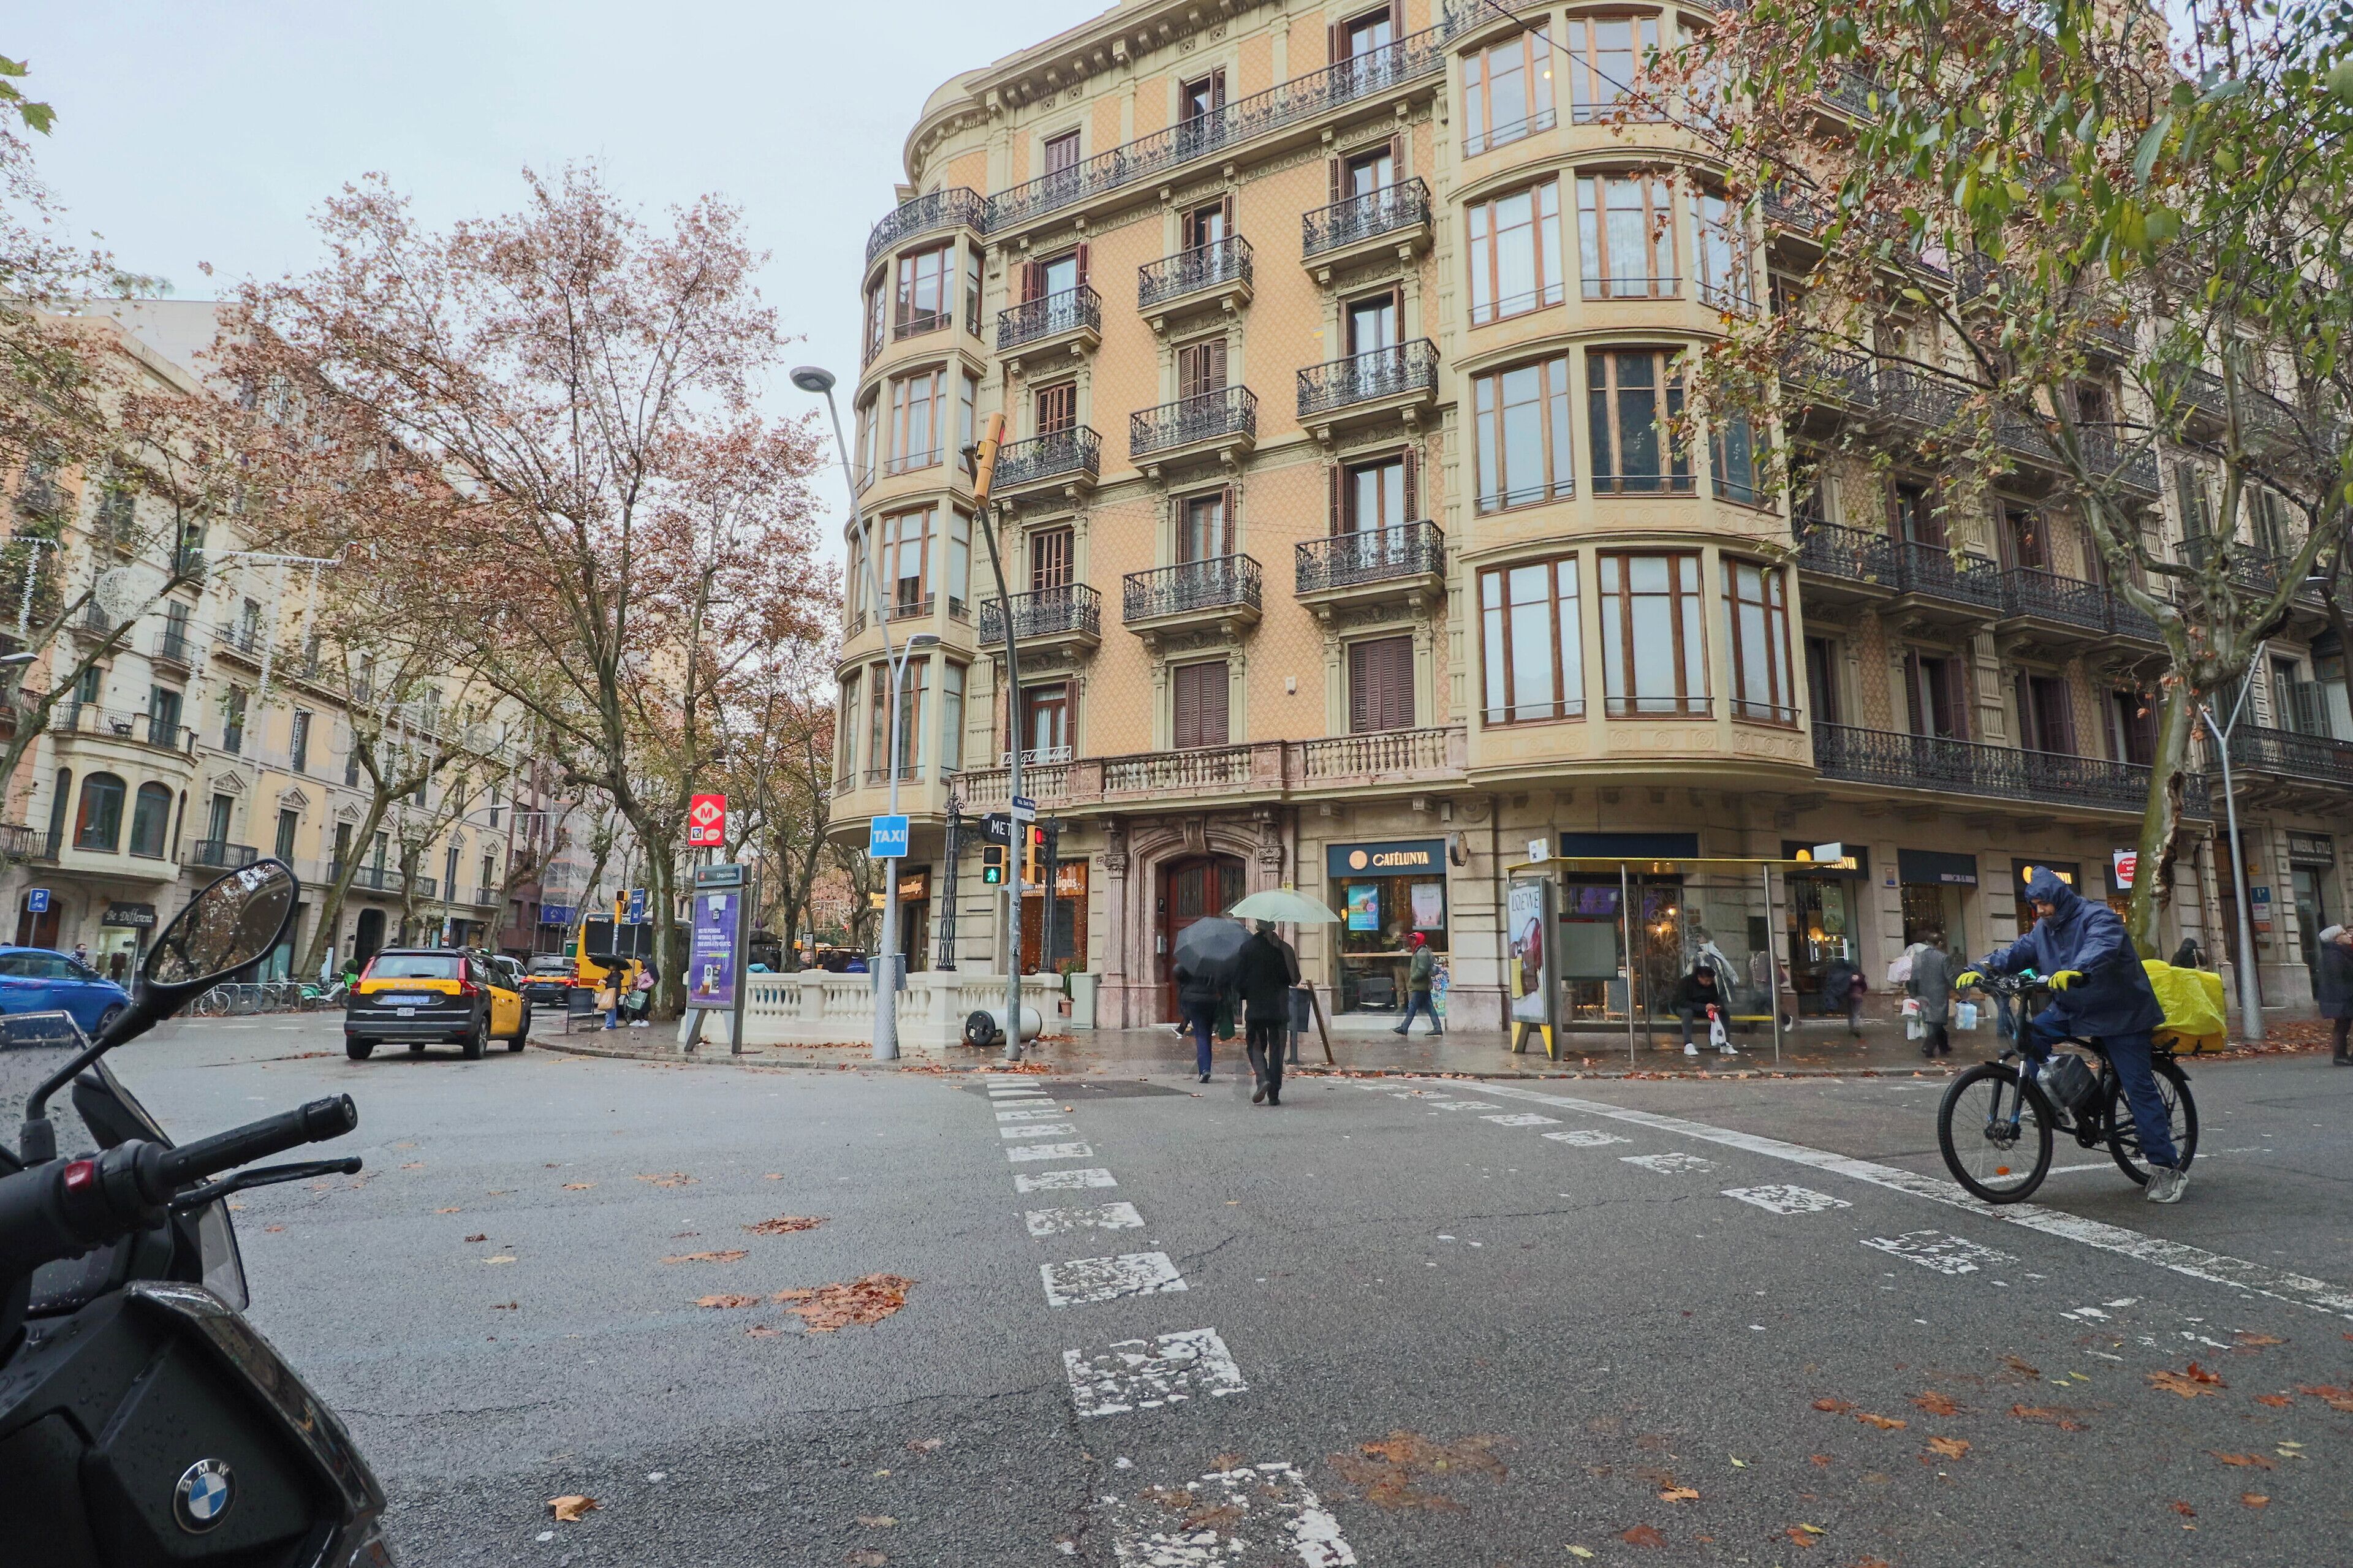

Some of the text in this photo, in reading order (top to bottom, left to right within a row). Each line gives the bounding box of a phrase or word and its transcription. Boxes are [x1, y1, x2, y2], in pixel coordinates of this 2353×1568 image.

[700, 808, 713, 819] M
[991, 819, 1025, 839] METO
[873, 830, 906, 843] TAXI
[2315, 841, 2332, 855] STYLE
[35, 892, 44, 901] P
[2257, 888, 2265, 898] P
[1512, 891, 1539, 912] LOEWE
[107, 908, 153, 925] Be Different
[181, 1461, 230, 1492] BMW
